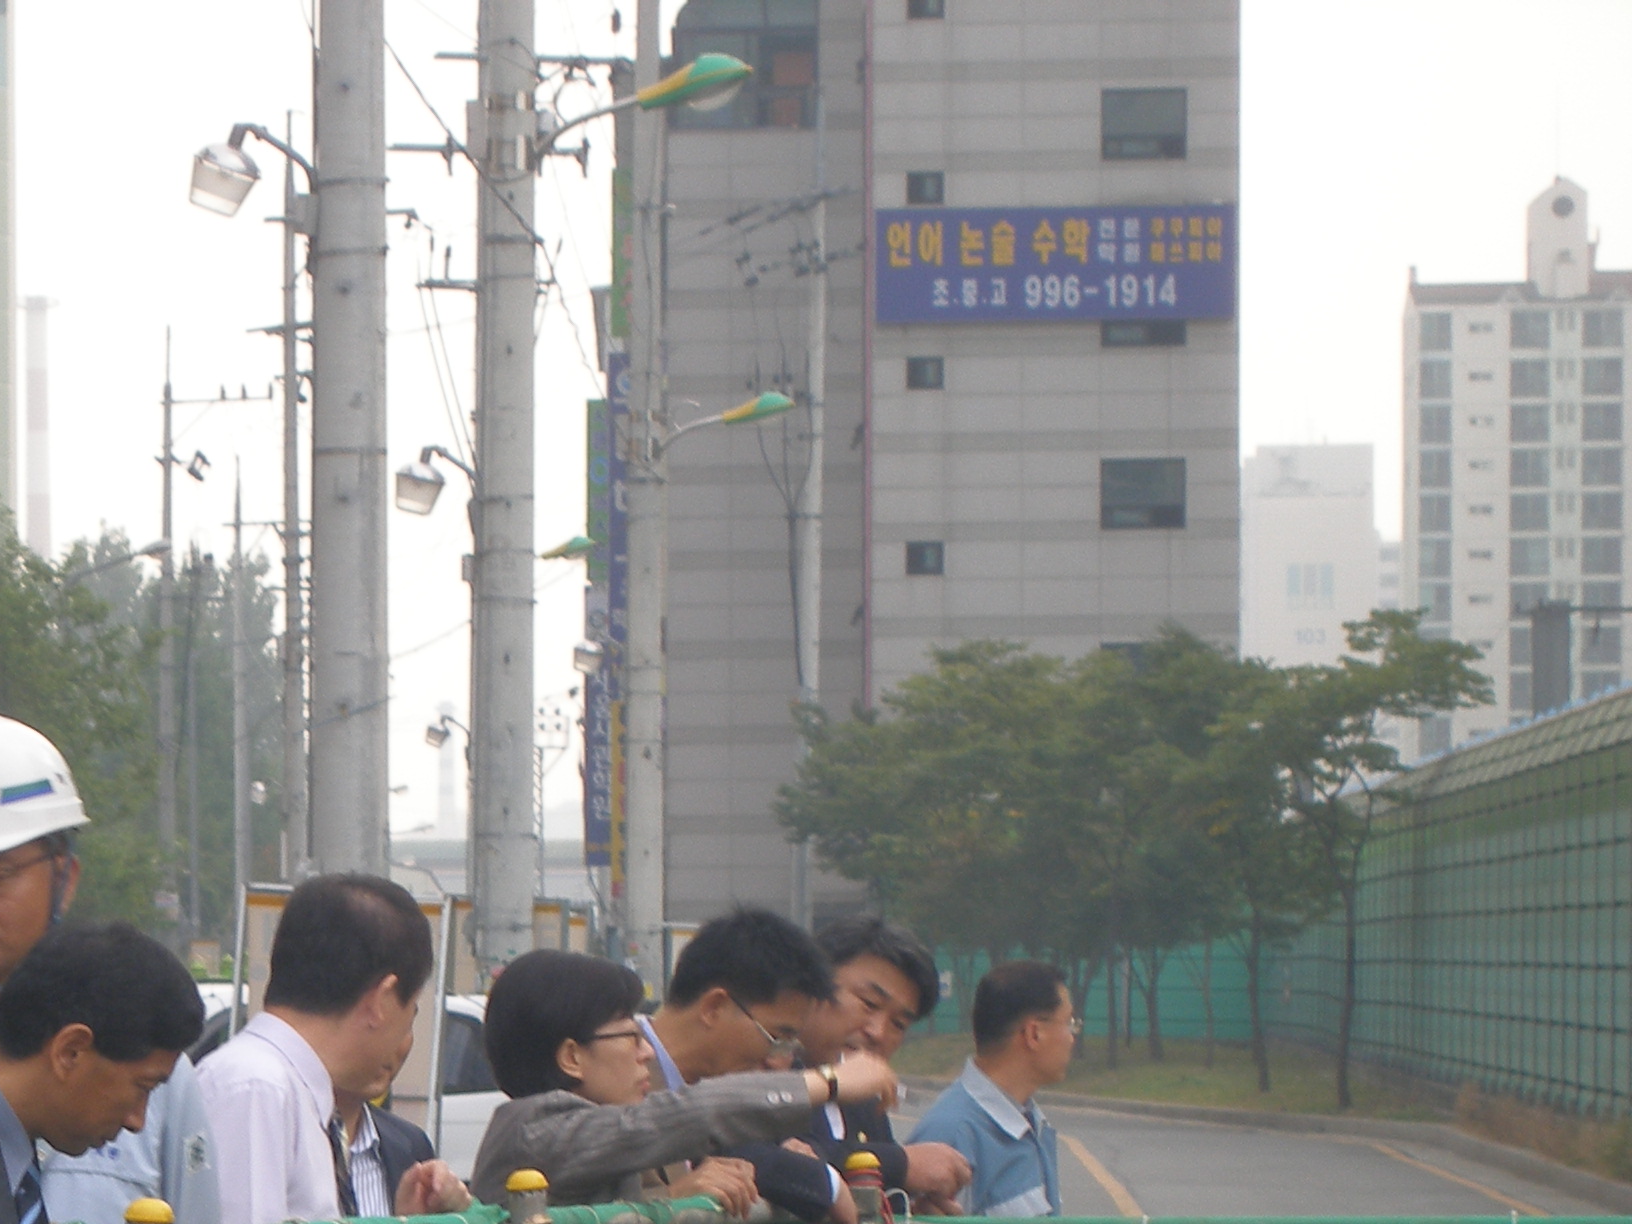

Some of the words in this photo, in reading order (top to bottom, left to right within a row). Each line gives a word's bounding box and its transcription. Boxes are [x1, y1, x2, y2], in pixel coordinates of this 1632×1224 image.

[887, 220, 943, 268] 언어
[959, 219, 1016, 267] 논술
[1032, 217, 1090, 265] 수학
[1024, 273, 1177, 309] 996-1914
